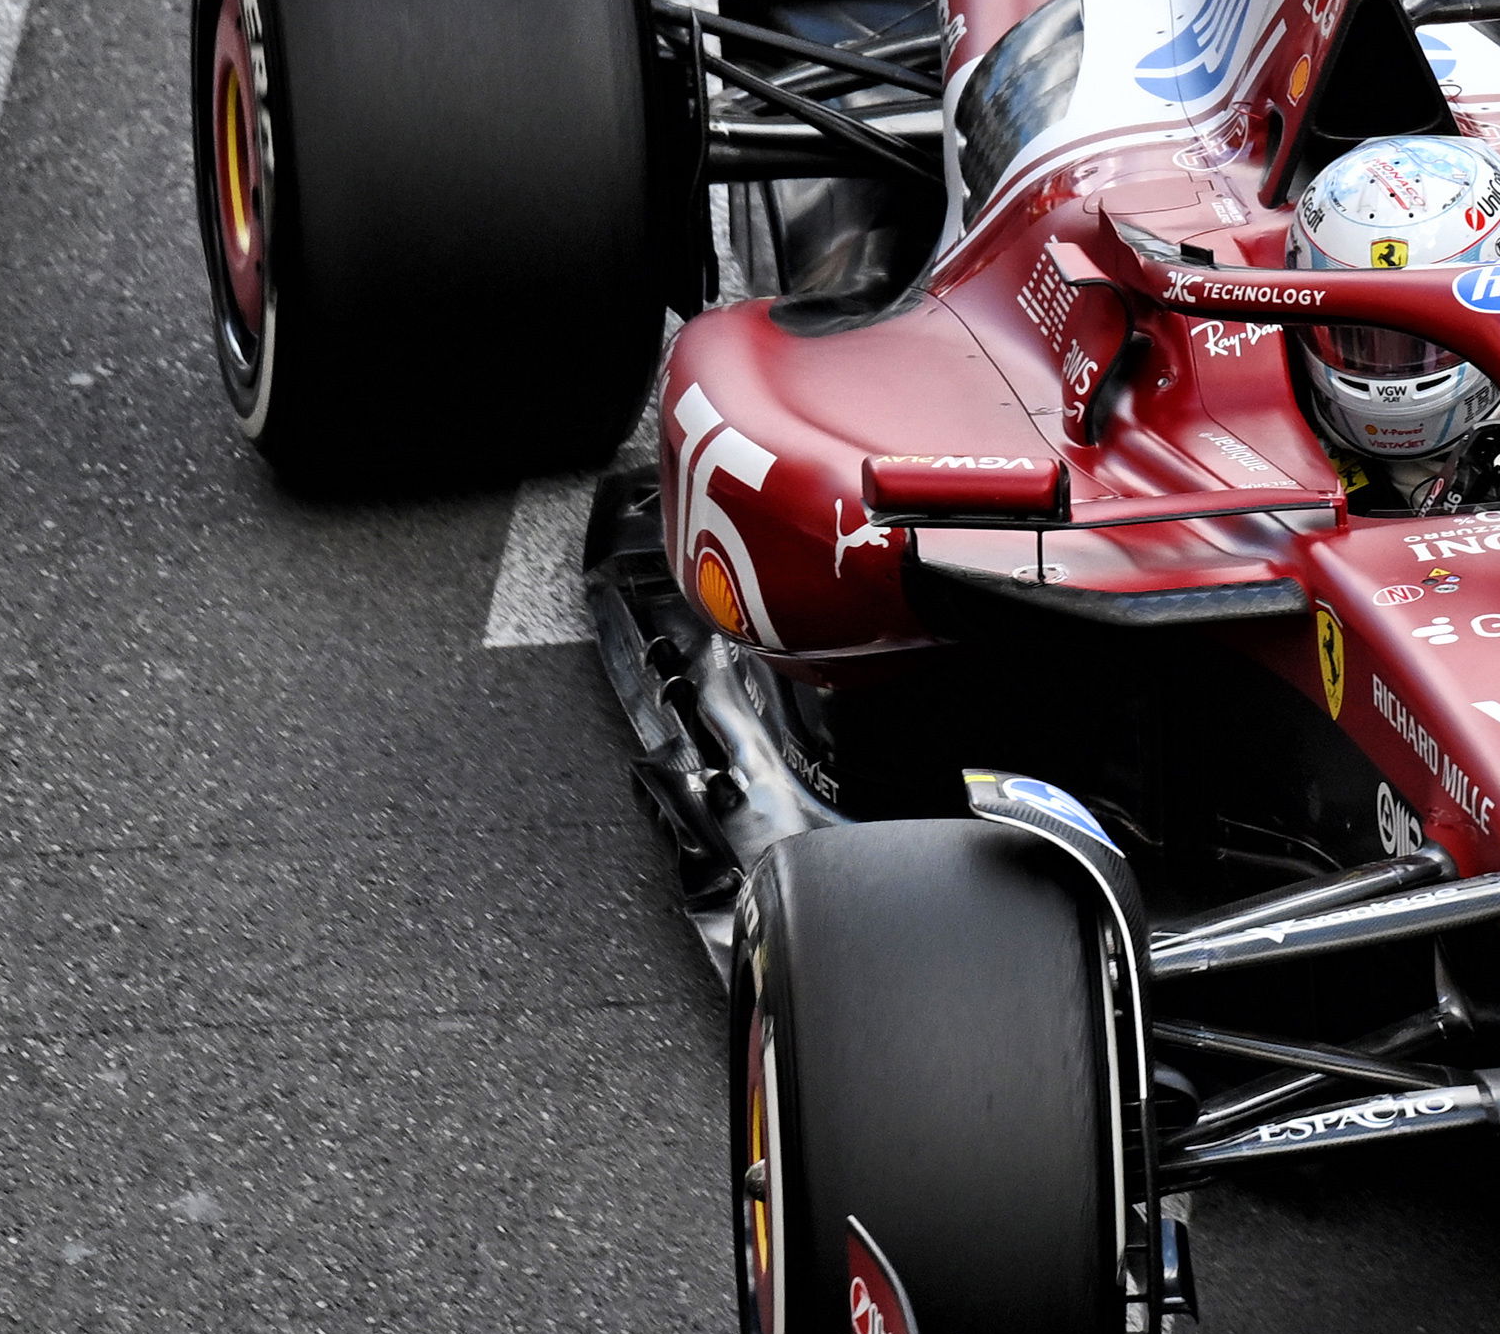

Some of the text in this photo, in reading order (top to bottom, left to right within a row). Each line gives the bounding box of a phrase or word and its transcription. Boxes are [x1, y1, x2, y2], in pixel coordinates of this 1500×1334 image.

[1301, 184, 1327, 234] Credit
[1203, 282, 1327, 307] TECHNOLOGY
[1376, 385, 1408, 397] VGW
[930, 456, 1036, 470] VGW
[1442, 490, 1463, 514] 16
[1372, 673, 1439, 776] RICHARD
[1440, 753, 1496, 835] MILLE
[1257, 1094, 1455, 1142] ESPACIO
